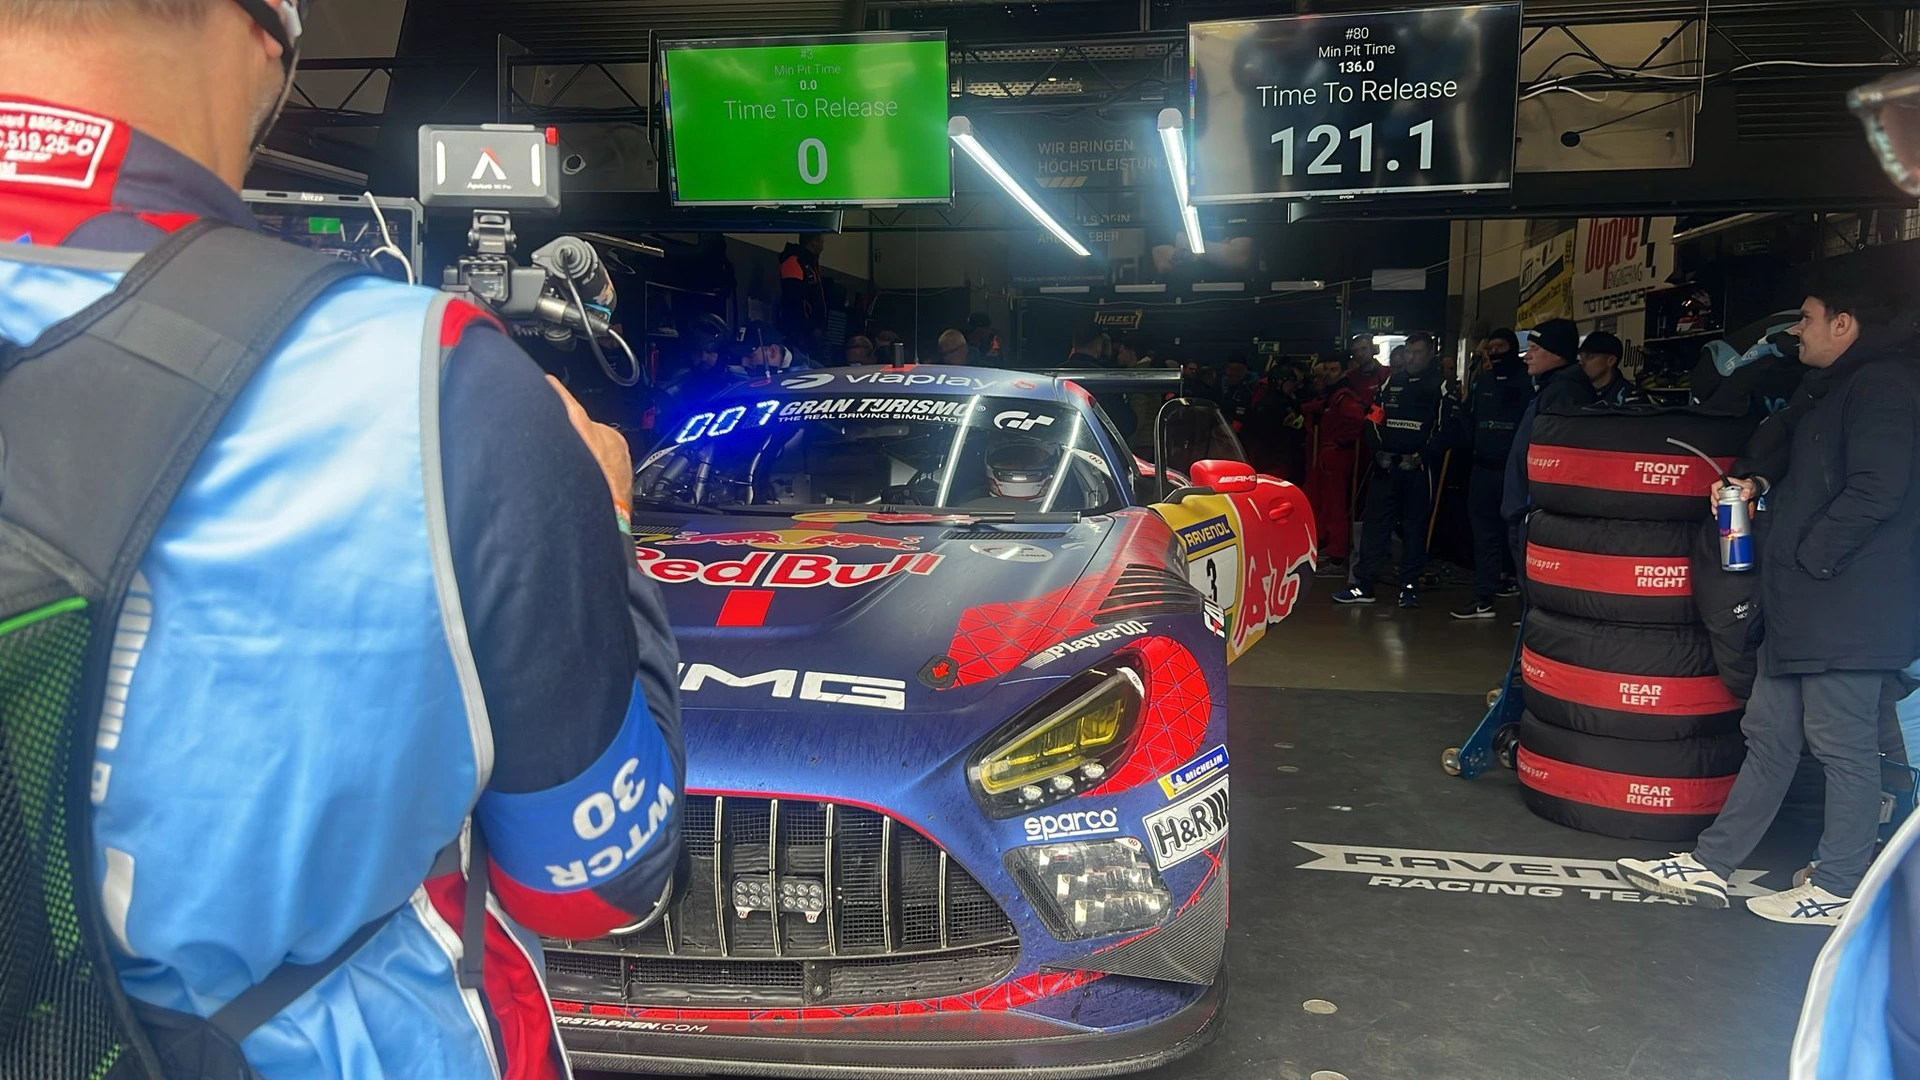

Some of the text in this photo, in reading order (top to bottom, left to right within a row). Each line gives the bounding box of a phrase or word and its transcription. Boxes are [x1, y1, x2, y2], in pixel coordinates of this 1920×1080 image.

[1345, 27, 1369, 39] #80
[1318, 43, 1396, 58] Min Pit Time
[774, 64, 841, 76] Min Pit Time
[1338, 61, 1375, 74] 136.0
[799, 80, 818, 91] 0.0
[1257, 78, 1458, 107] Time To Release
[724, 97, 898, 120] Time To Release
[1038, 139, 1134, 155] WIR BRINGEN
[1271, 119, 1433, 176] 121.1
[798, 138, 828, 185] 0
[1037, 157, 1158, 174] HÖCHSTLEISTUN
[845, 371, 999, 391] viaplay
[777, 414, 801, 423] THE
[804, 413, 838, 421] REAL
[841, 412, 890, 420] DRIVING
[778, 398, 971, 418] GRAN TURISMO
[676, 399, 780, 443] 007
[1234, 474, 1257, 483] AMG
[1634, 461, 1690, 476] FRONT
[1642, 473, 1680, 486] LEFT
[1186, 521, 1231, 548] RAVENOL
[762, 551, 946, 588] Bull
[1634, 565, 1689, 577] FRONT
[1206, 557, 1218, 603] 3
[1636, 577, 1686, 588] RIGHT
[678, 662, 907, 711] MG
[1619, 682, 1663, 696] REAR
[1621, 694, 1660, 707] LEFT
[1184, 752, 1224, 783] MICHELIN
[572, 757, 646, 840] 30
[1629, 783, 1672, 797] REAR
[1626, 794, 1674, 808] RIGHT
[1024, 808, 1117, 840] sparco
[1154, 805, 1213, 856] H&R
[544, 782, 675, 887] WTCR
[1343, 852, 1620, 881] RAVEN
[1367, 875, 1564, 898] RACING
